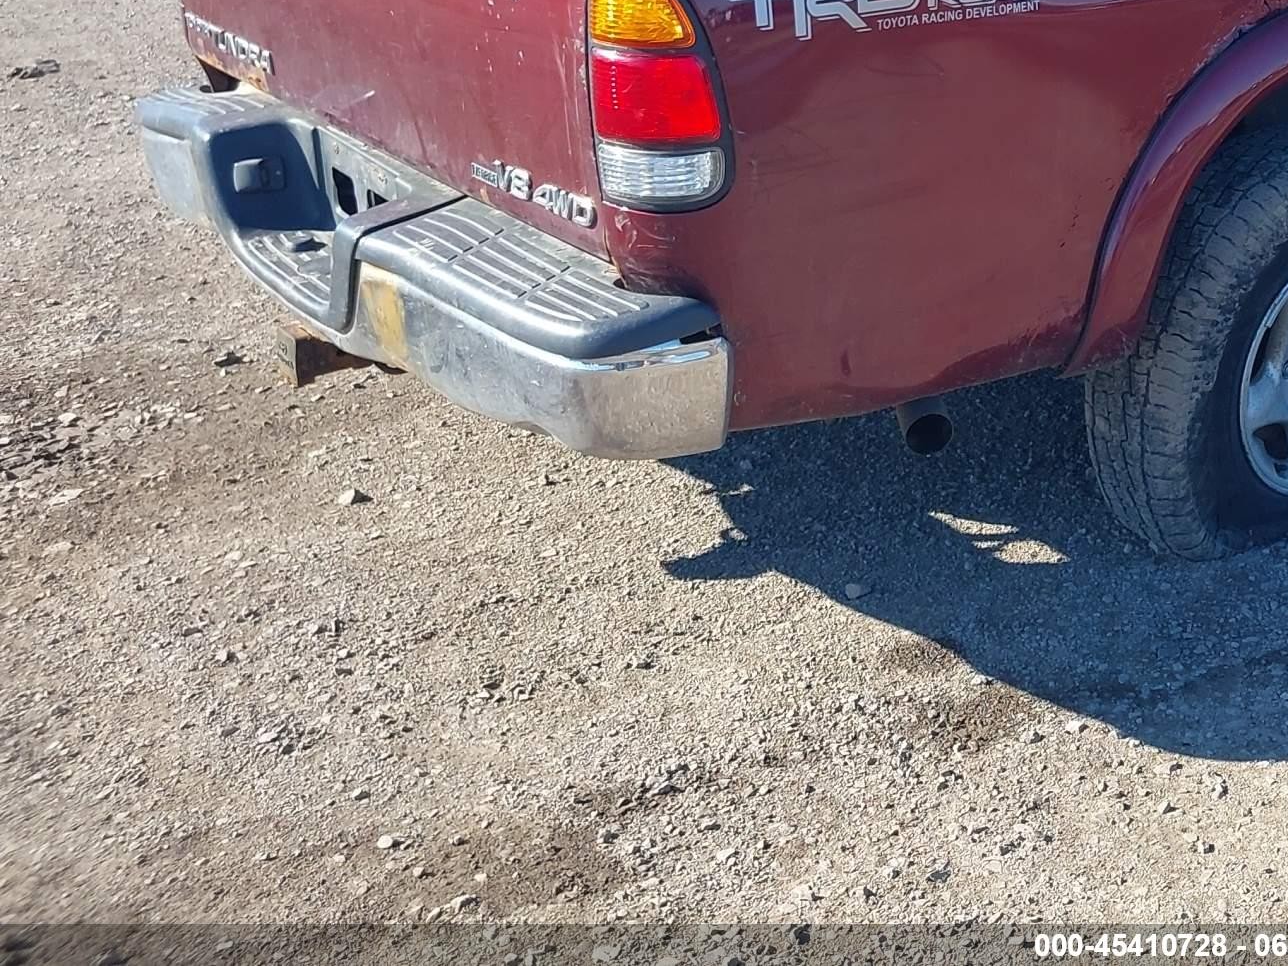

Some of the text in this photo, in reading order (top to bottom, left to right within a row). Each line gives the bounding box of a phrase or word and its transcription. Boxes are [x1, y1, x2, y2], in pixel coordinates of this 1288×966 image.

[877, 0, 1041, 31] TOYOTA RACING DEVELOPMENT
[493, 159, 533, 202] V8
[533, 183, 599, 230] 4WD
